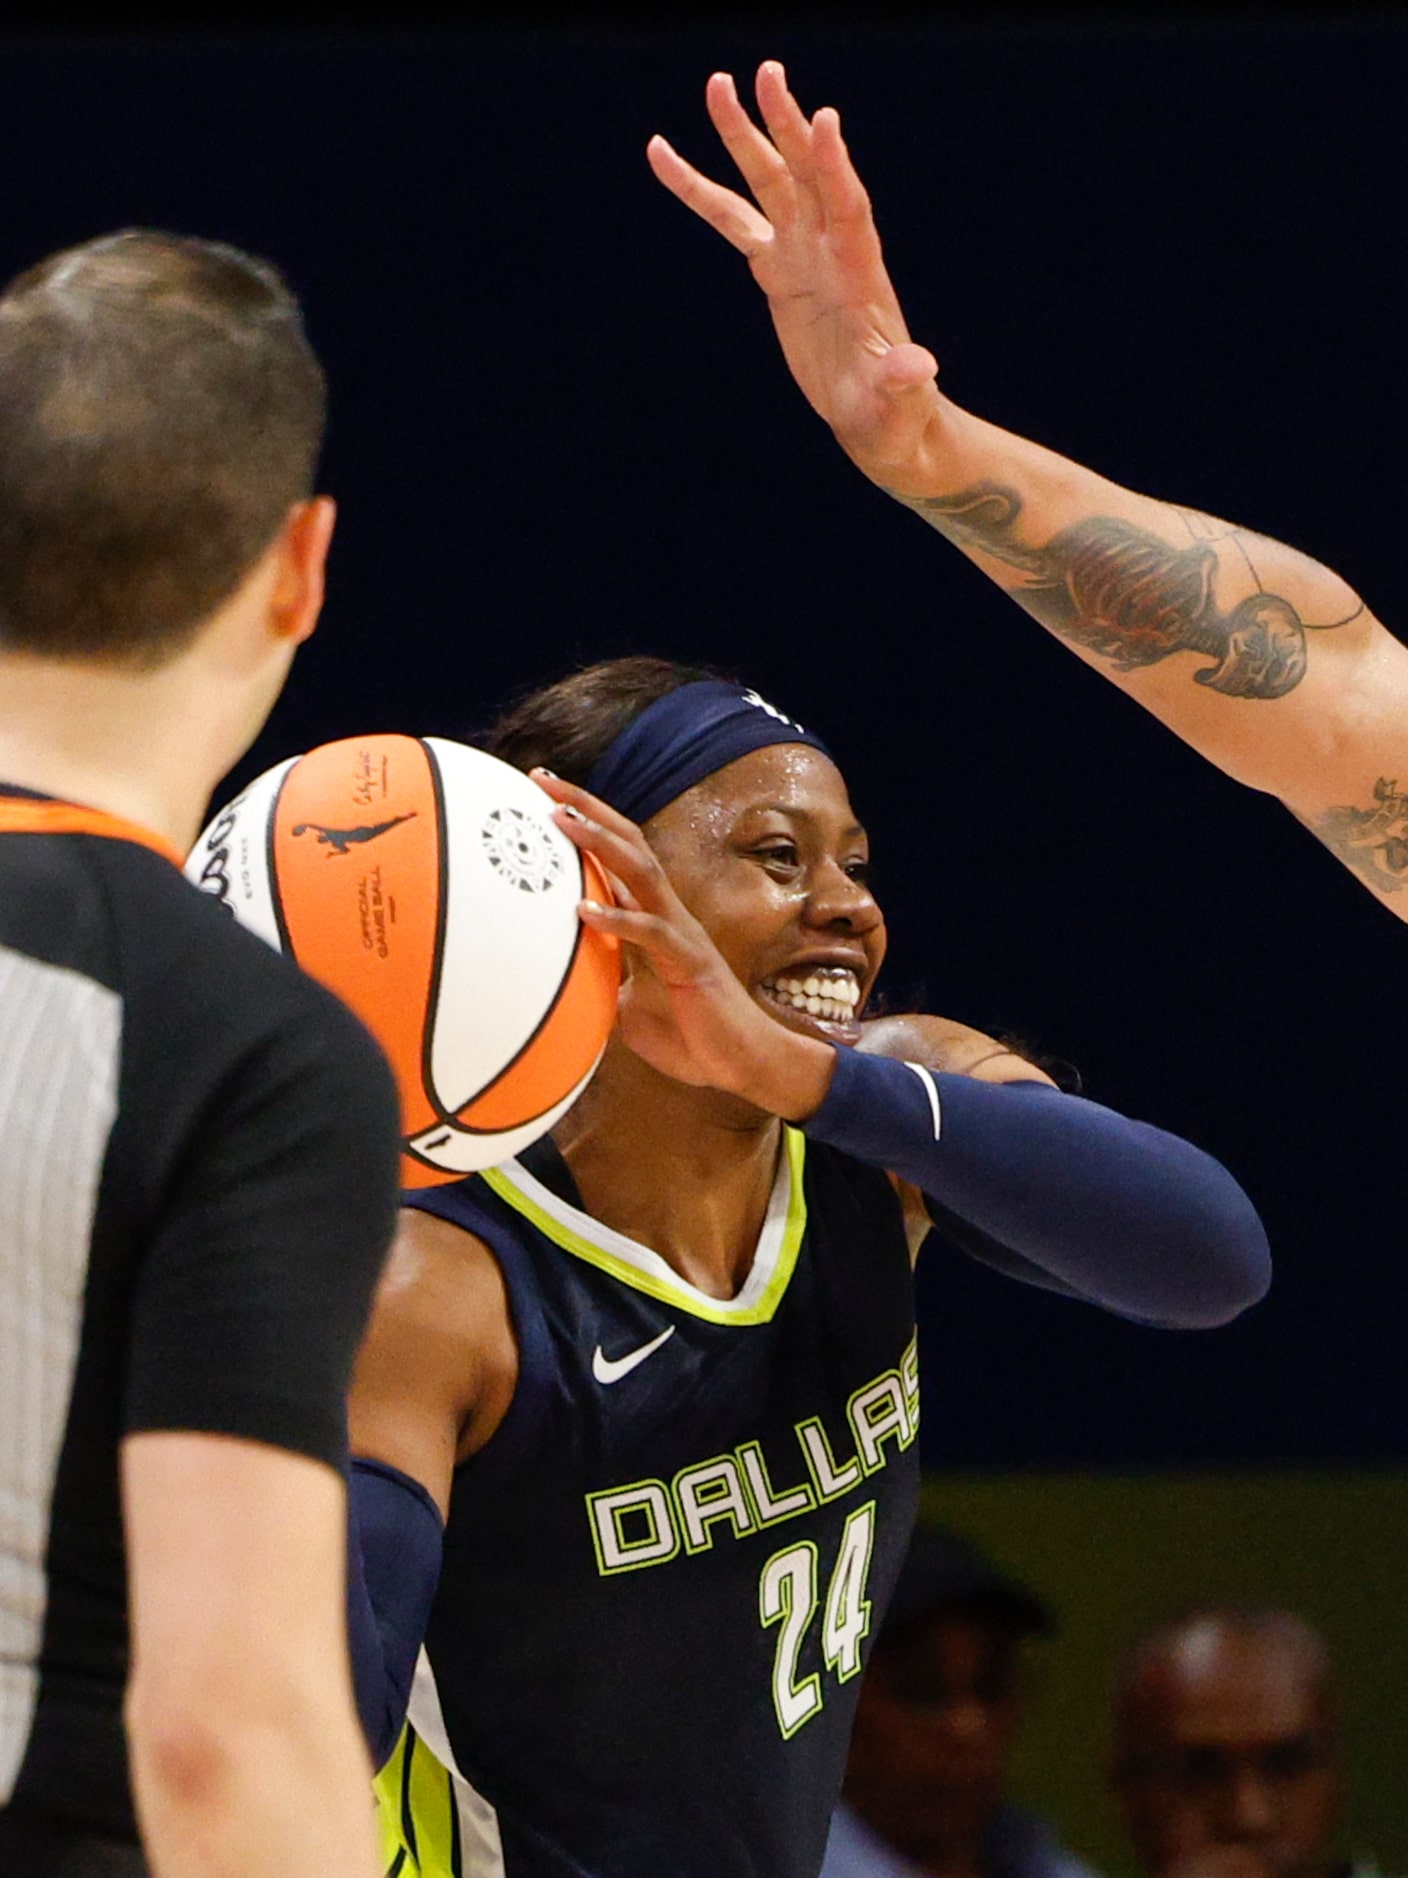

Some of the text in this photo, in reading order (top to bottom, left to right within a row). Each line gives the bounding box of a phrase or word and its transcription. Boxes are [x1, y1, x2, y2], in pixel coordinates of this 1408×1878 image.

[359, 876, 374, 950] OFFICIAL
[371, 865, 389, 960] GAME BALL
[758, 1499, 877, 1741] 24
